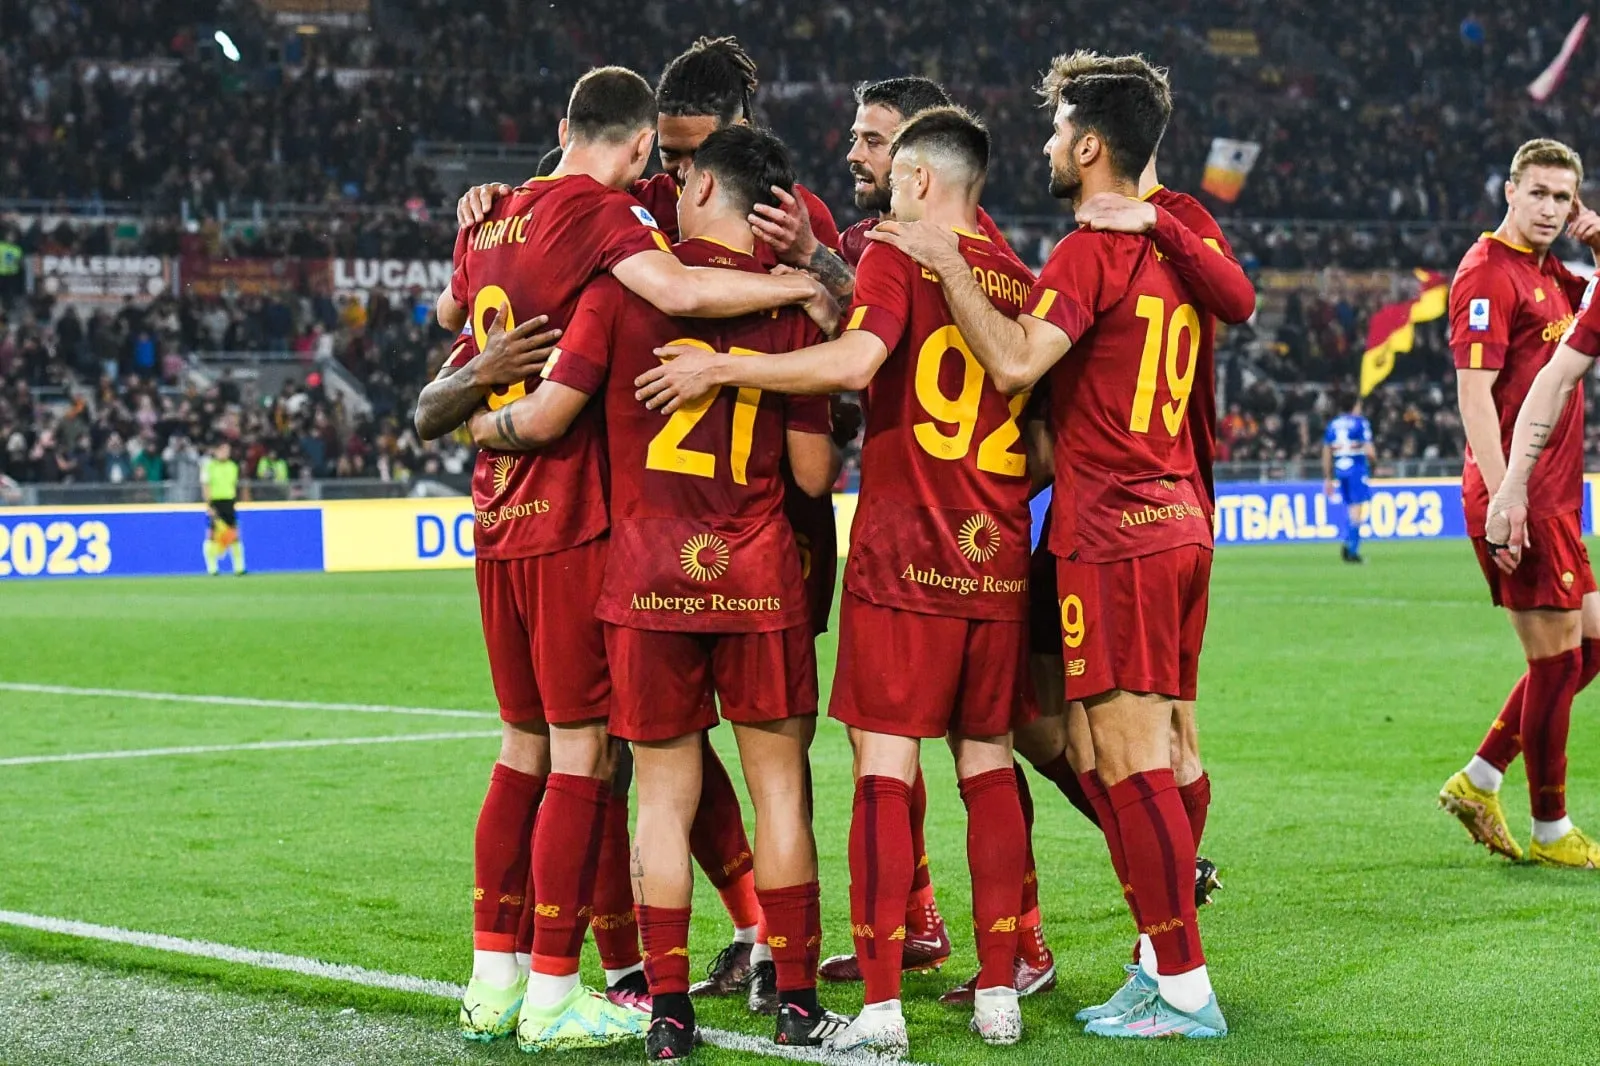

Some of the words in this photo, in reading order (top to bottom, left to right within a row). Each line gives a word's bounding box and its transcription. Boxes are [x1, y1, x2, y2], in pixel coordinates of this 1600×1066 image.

[43, 255, 162, 275] PALERMO
[333, 257, 453, 289] LUCAN
[1129, 294, 1200, 437] 19
[913, 325, 1031, 477] 92
[499, 499, 550, 521] Resorts
[1120, 504, 1188, 528] Auberge
[1214, 493, 1339, 542] TBALL
[900, 563, 979, 596] Auberge
[982, 575, 1029, 593] Resort
[630, 592, 706, 615] Auberge
[711, 594, 781, 612] Resorts
[1058, 594, 1085, 648] 9
